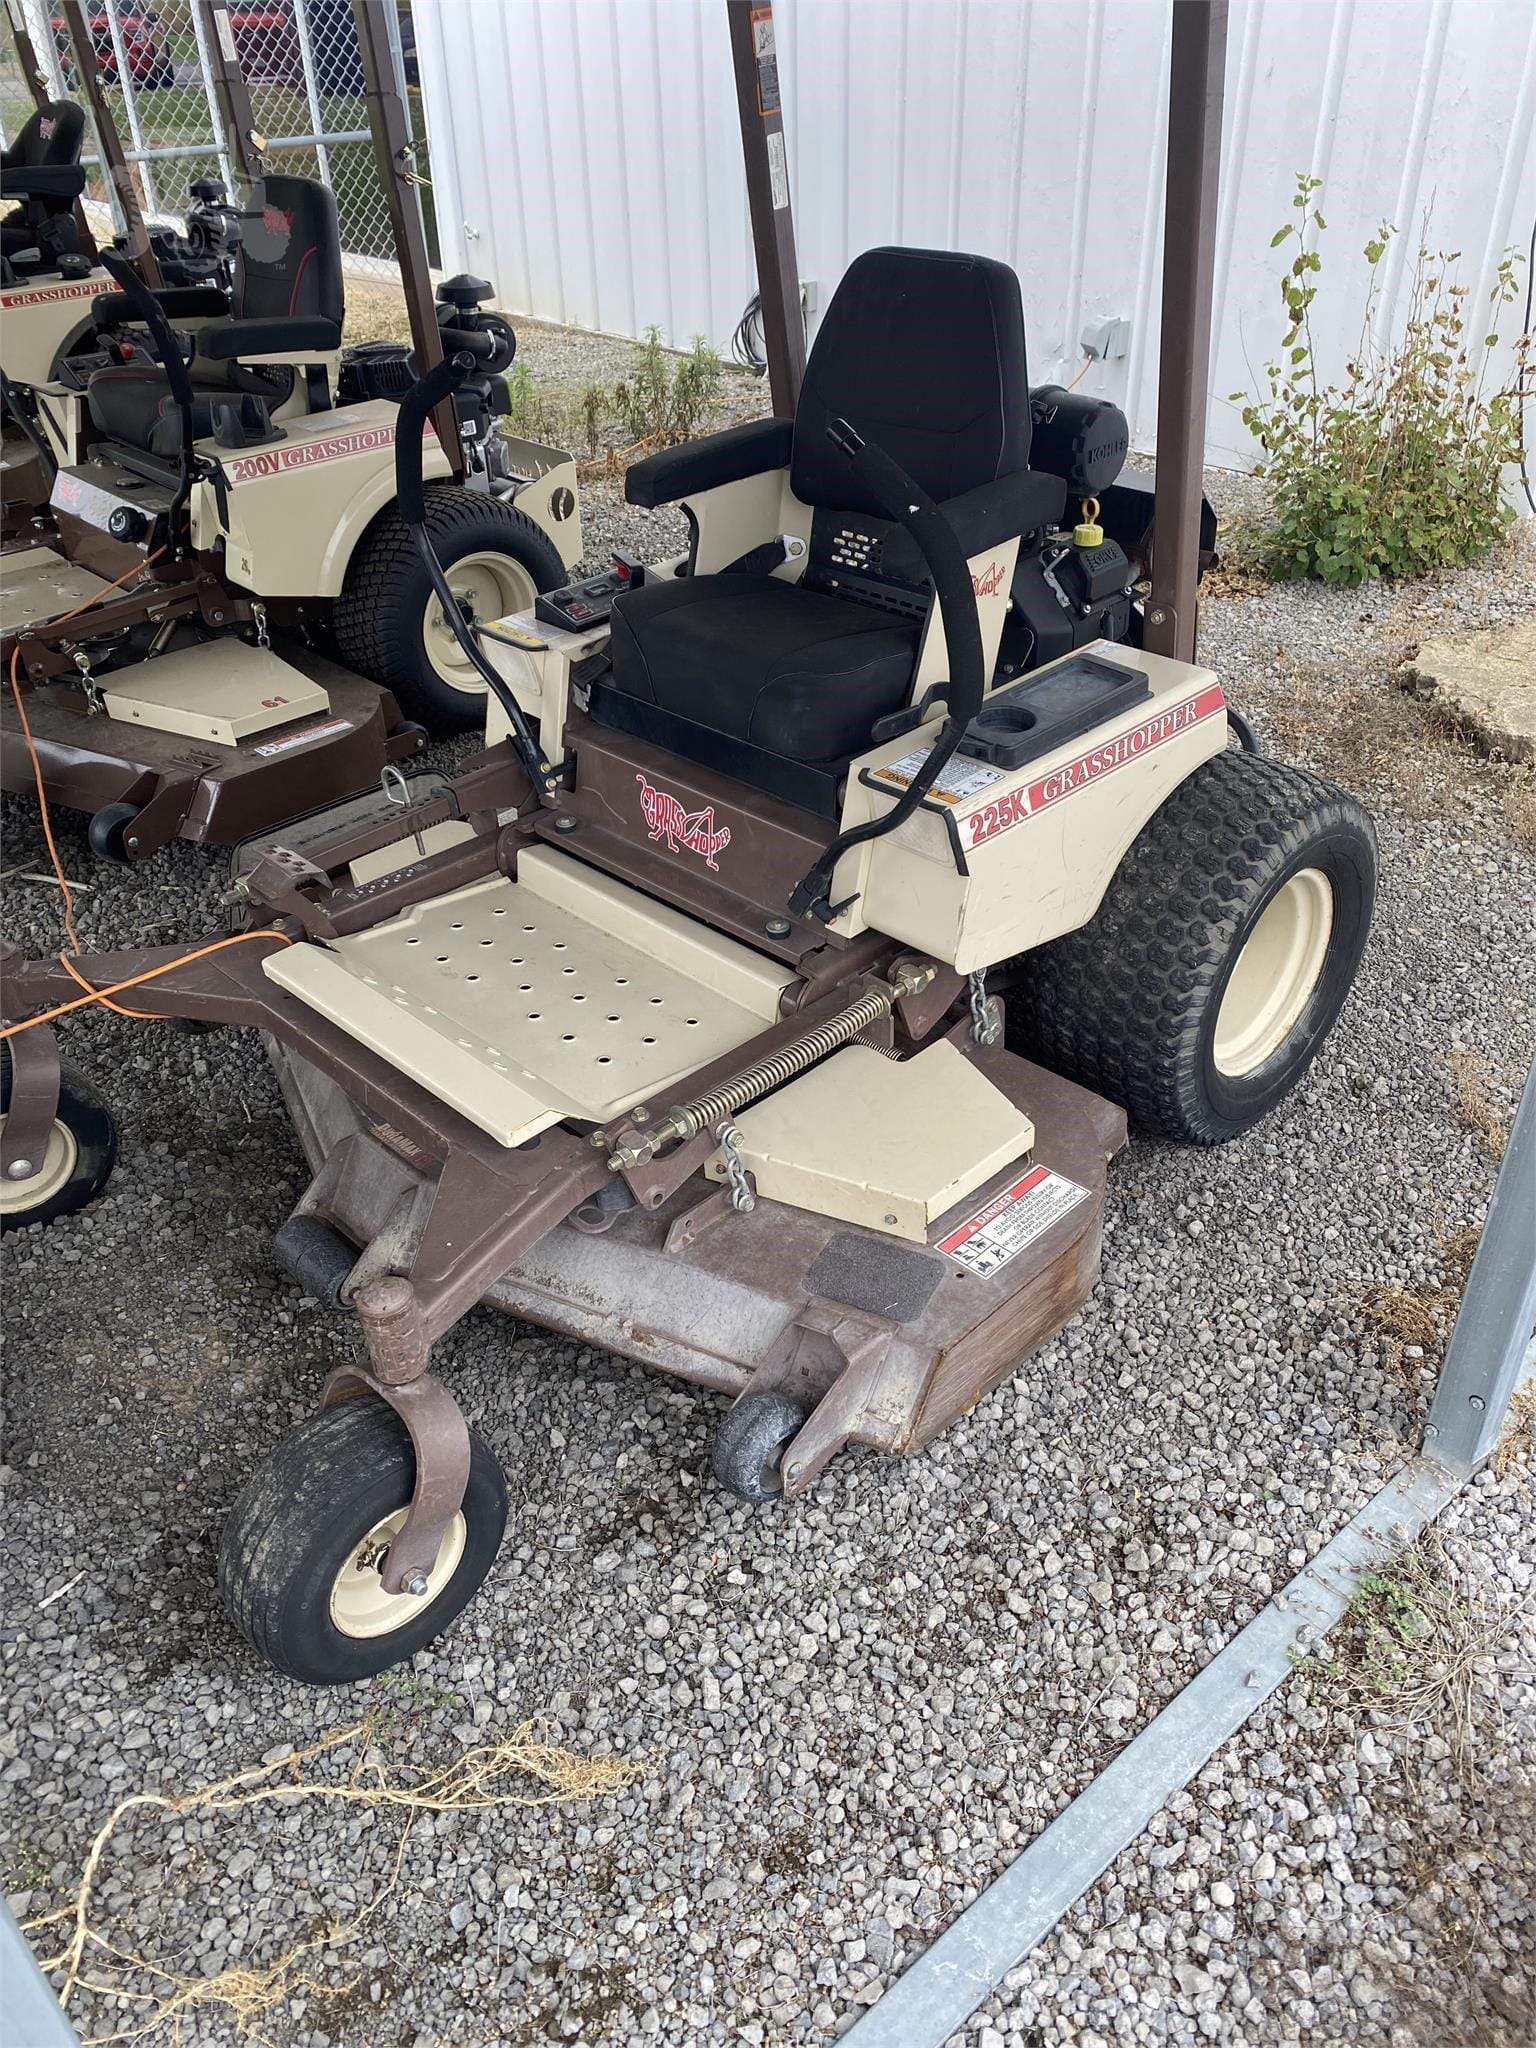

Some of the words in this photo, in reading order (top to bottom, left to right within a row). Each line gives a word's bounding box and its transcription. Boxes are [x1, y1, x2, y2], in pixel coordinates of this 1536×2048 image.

[10, 282, 116, 306] GRASSHOPPER
[232, 453, 280, 480] 200V
[287, 427, 397, 466] GRASSHOPP
[261, 696, 289, 709] 61
[970, 789, 1028, 844] 225K
[1043, 701, 1197, 800] GRASSHOPPER
[975, 1194, 1014, 1224] DANGER
[1001, 1205, 1016, 1216] KEEP
